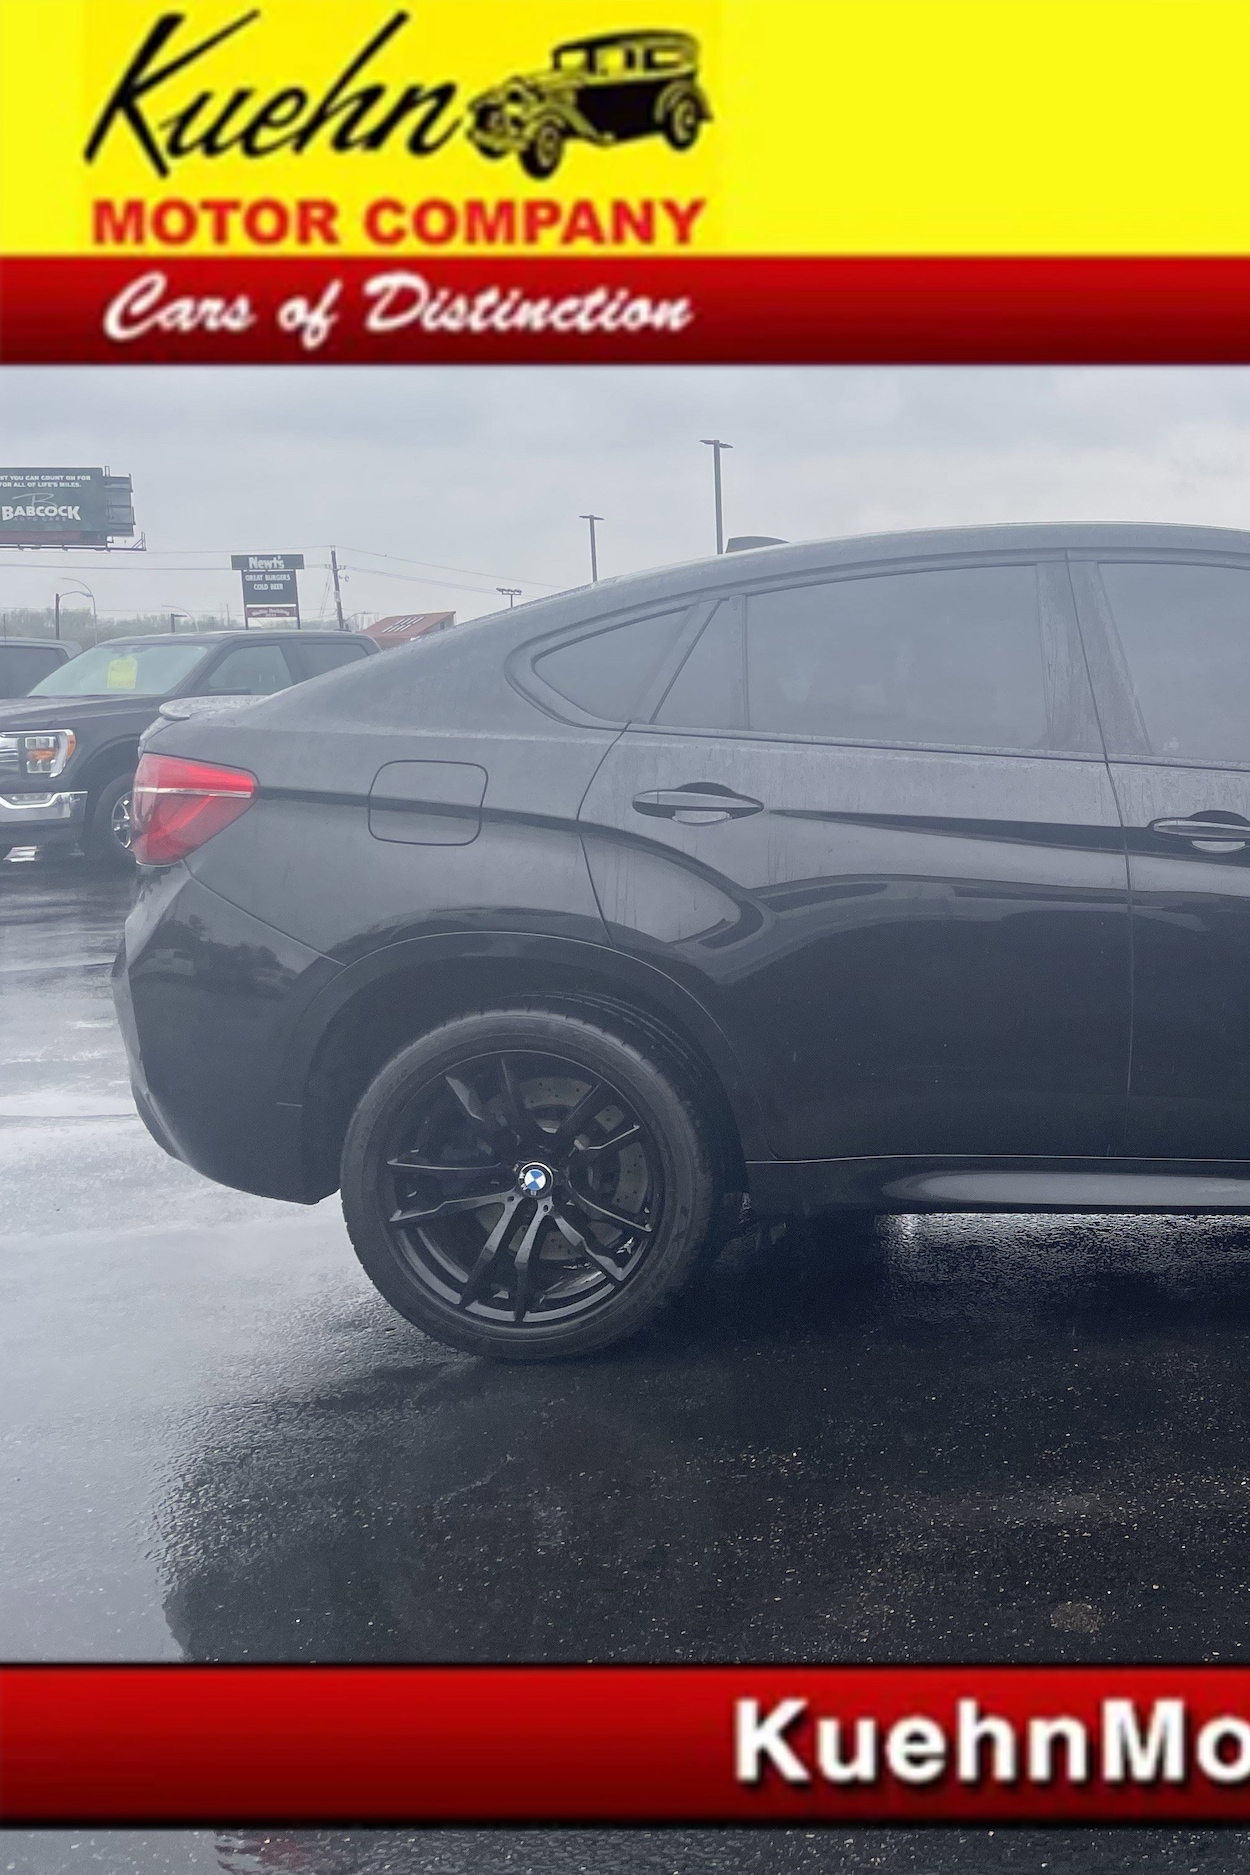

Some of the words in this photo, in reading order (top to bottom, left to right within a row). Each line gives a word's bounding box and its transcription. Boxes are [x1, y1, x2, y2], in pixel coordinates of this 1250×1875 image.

[1, 505, 82, 521] BABCOCK
[248, 555, 285, 569] Newt's
[245, 574, 264, 582] GREAT
[264, 573, 291, 581] BURGERS
[253, 583, 269, 591] COLD
[270, 583, 284, 591] BEER
